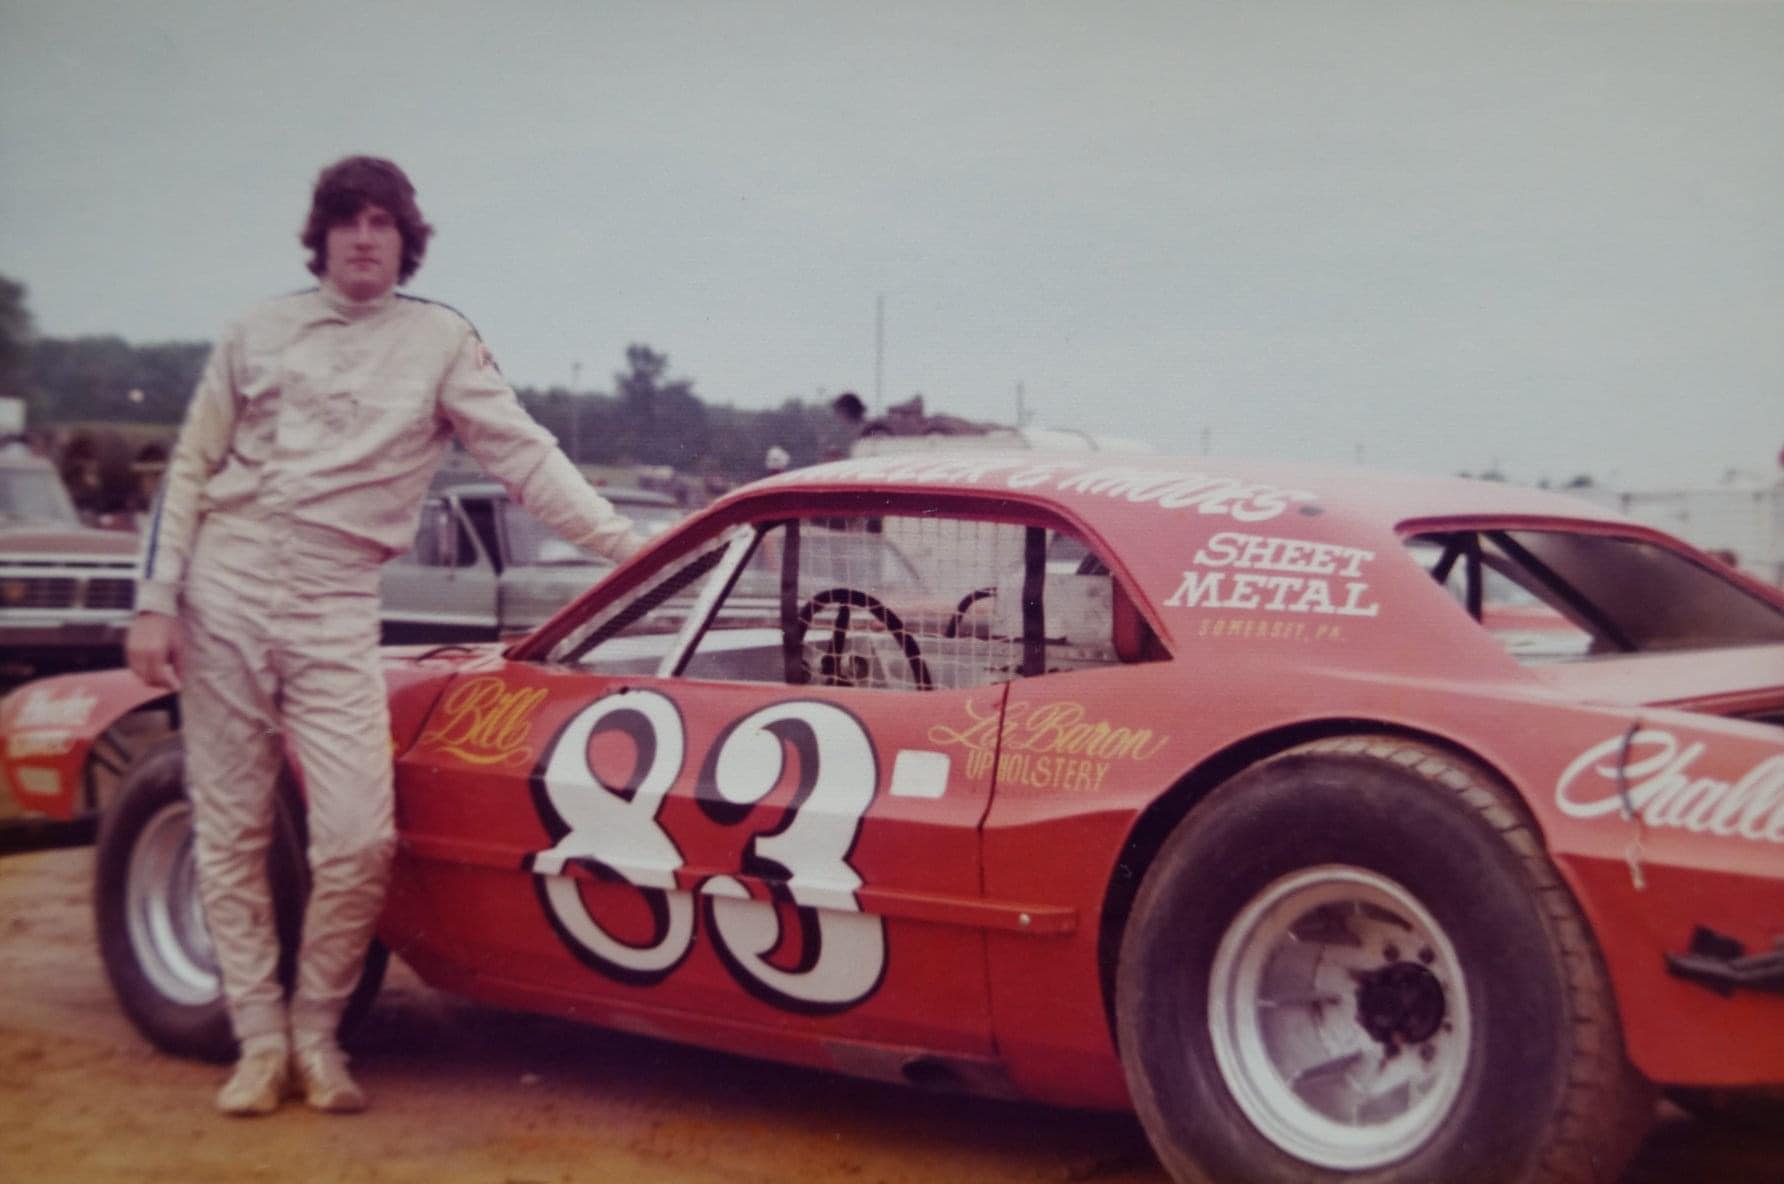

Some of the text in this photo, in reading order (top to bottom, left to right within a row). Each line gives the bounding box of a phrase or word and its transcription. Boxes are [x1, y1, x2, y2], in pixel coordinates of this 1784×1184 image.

[1193, 532, 1377, 577] SHEET
[1163, 570, 1380, 617] METAL
[421, 676, 549, 750] Bill
[965, 750, 1111, 792] UPHOLSTERY
[1554, 730, 1784, 843] Chall
[521, 687, 890, 1017] 83
